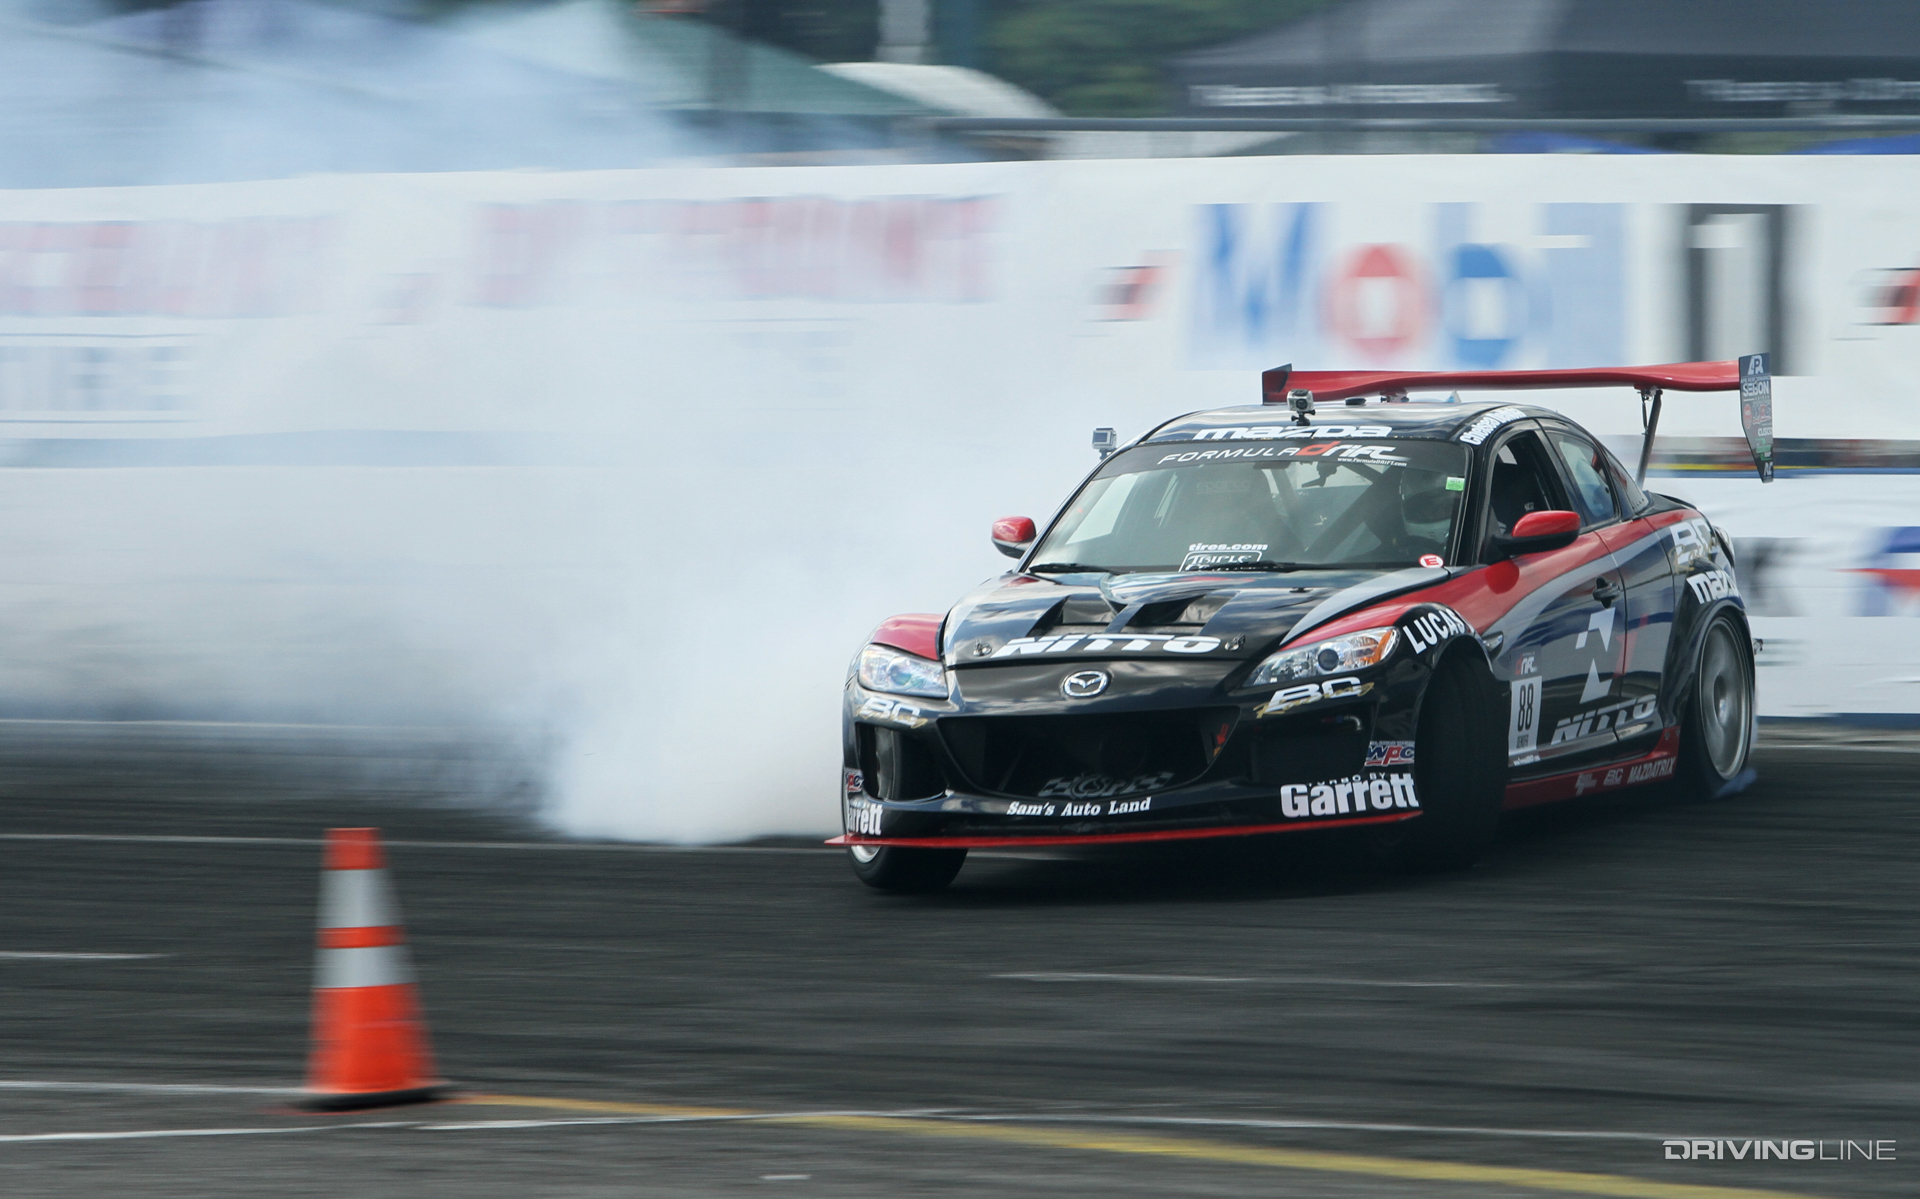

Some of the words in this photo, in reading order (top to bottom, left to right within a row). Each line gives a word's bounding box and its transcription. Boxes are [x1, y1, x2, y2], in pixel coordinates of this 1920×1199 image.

[1743, 381, 1770, 397] SEBON
[1193, 425, 1394, 441] mazda
[1157, 448, 1300, 465] FORMULA
[1188, 542, 1269, 552] tires.com
[1402, 609, 1466, 654] LUCAS
[991, 633, 1222, 659] NITTO
[1266, 676, 1362, 712] BC
[1517, 682, 1535, 732] 88
[1550, 693, 1658, 746] NITTO
[1369, 772, 1387, 781] BY
[1280, 772, 1420, 817] Garrett
[1006, 801, 1056, 816] Sam's
[1060, 802, 1102, 817] Auto
[1107, 797, 1152, 815] Land
